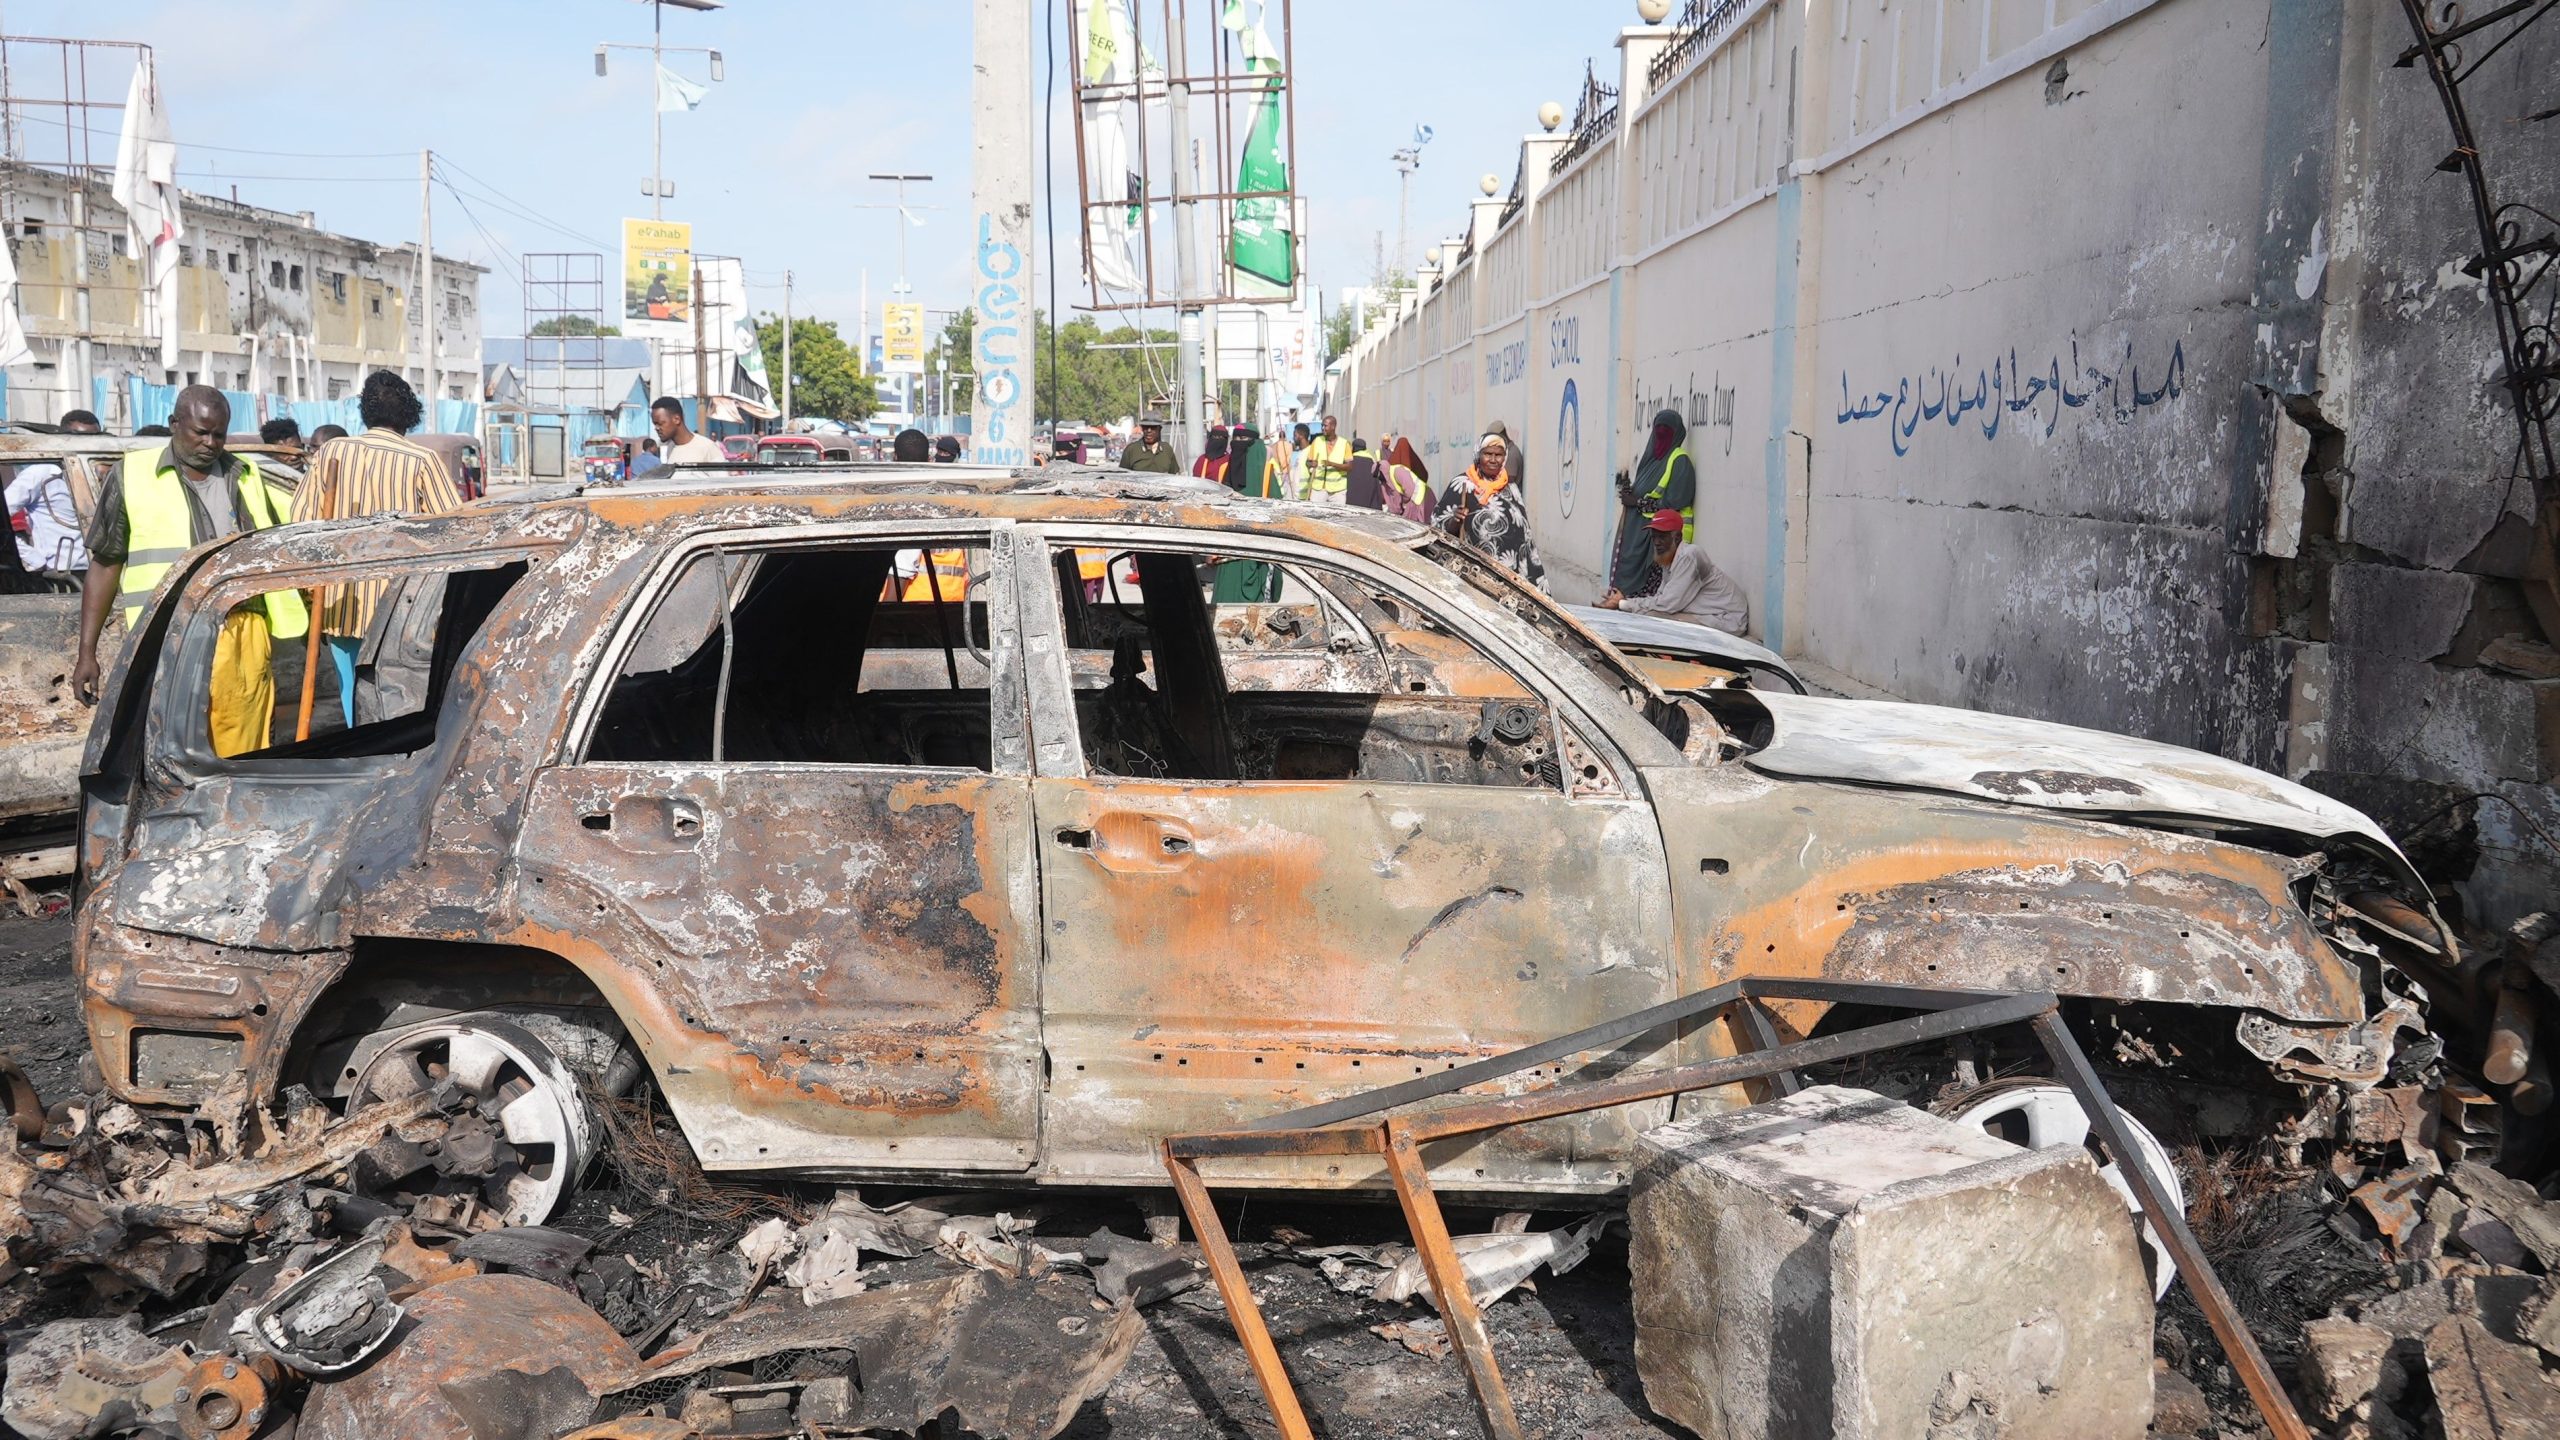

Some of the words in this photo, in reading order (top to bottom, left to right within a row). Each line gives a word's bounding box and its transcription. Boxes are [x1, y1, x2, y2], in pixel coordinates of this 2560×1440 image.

[898, 316, 911, 336] 3
[1551, 316, 1580, 369] SCHOOL
[1946, 352, 2002, 441] ومن
[2113, 339, 2186, 426] من
